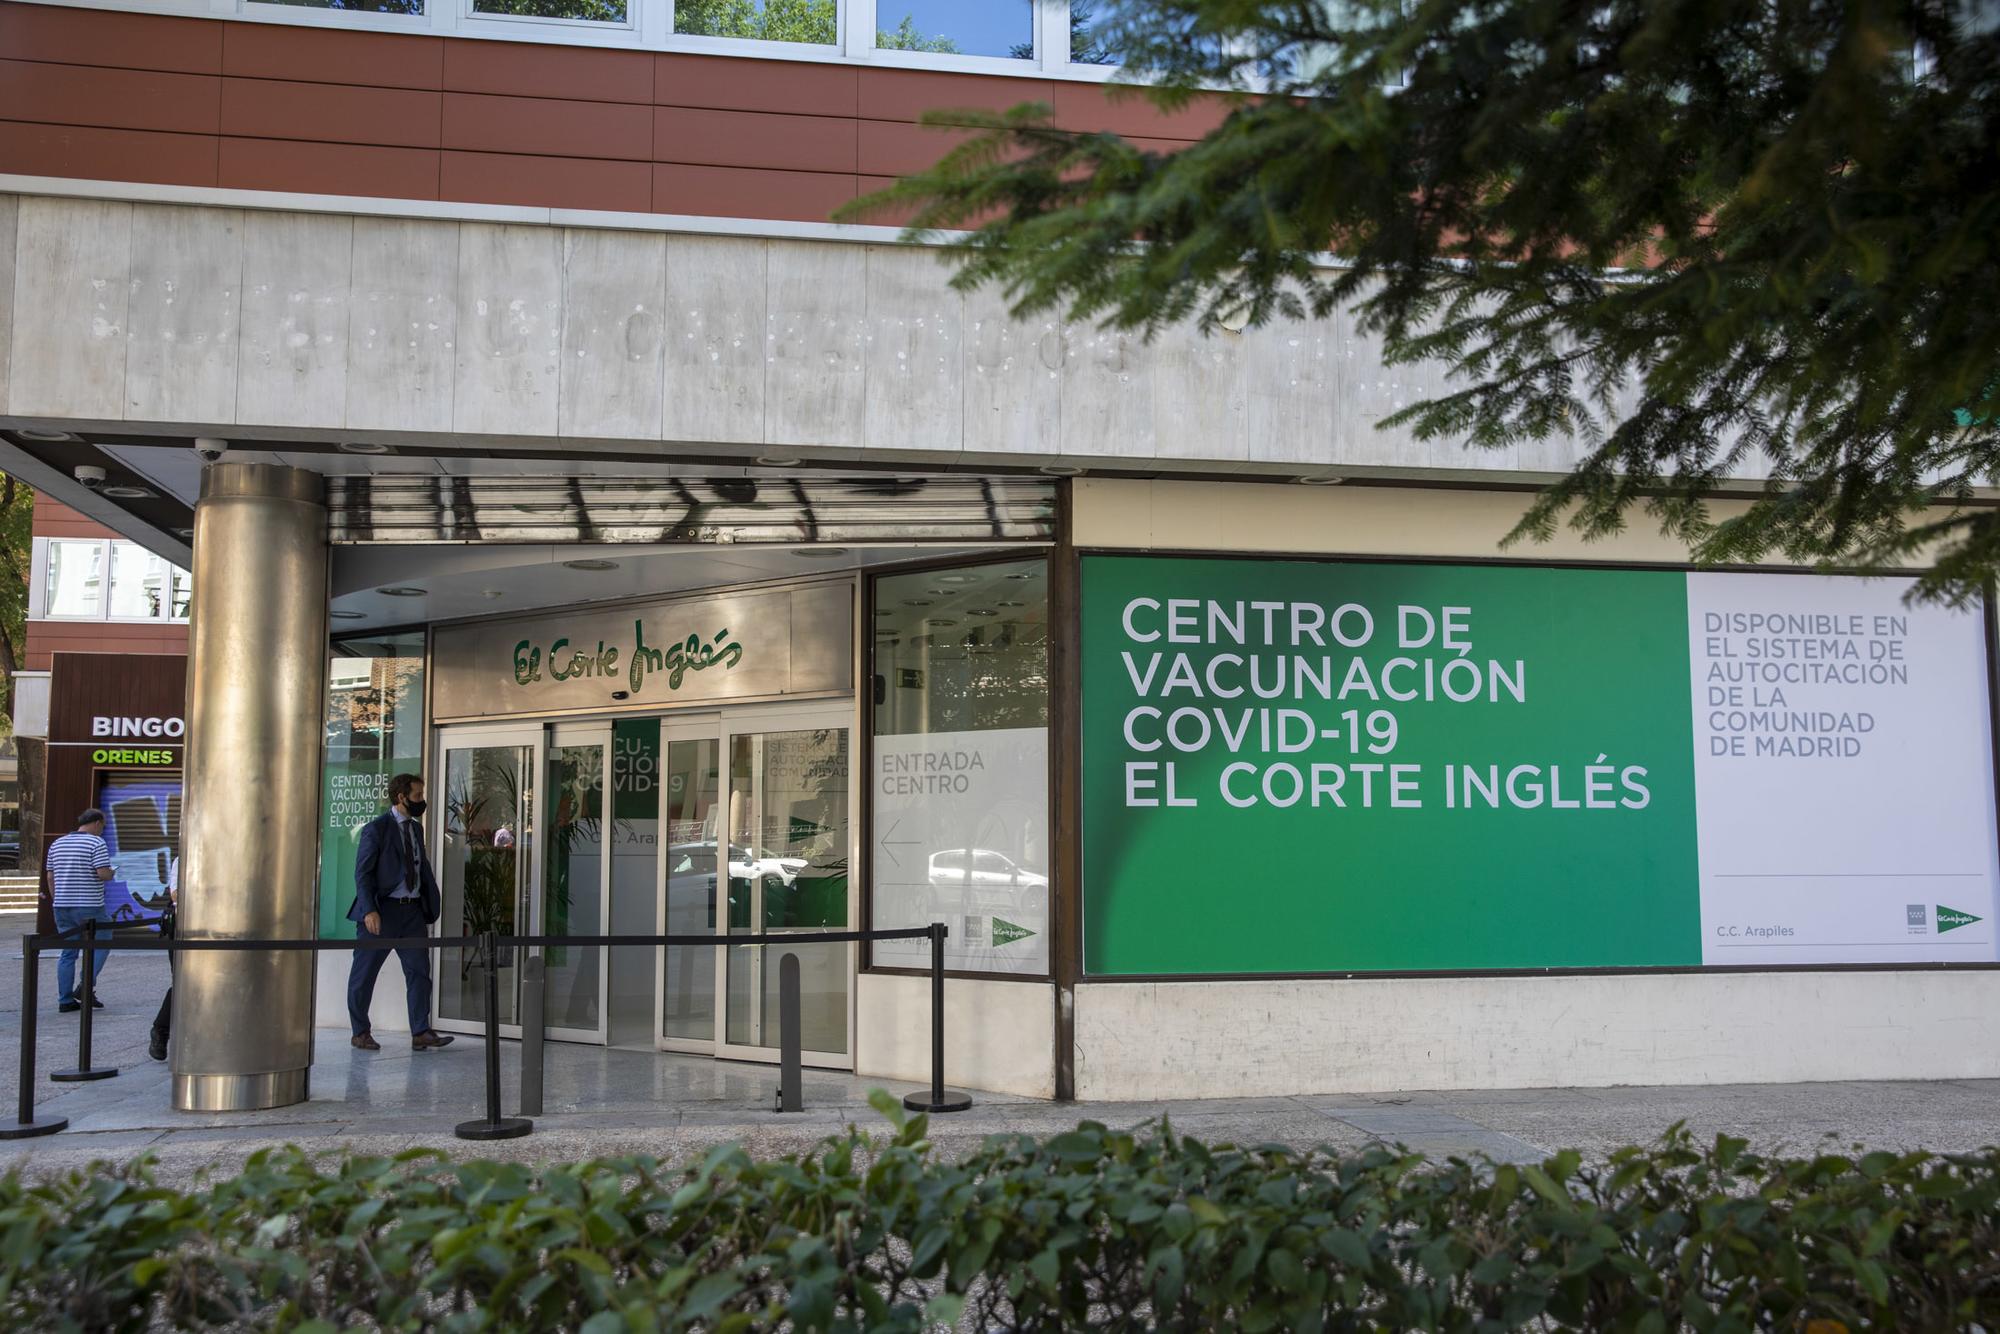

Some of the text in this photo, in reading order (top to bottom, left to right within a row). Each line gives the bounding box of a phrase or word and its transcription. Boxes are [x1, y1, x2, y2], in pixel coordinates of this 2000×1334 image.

[1122, 597, 1473, 650] CENTRO DE
[1704, 612, 1908, 637] DISPONIBLE EN
[513, 618, 743, 694] El Corte Inglés
[1706, 637, 1904, 661] EL SISTEMA DE
[1120, 646, 1526, 703] VACUNACIÓN
[1706, 656, 1908, 685] AUTOCITACIÓN
[1708, 686, 1788, 708] DE LA
[92, 715, 185, 738] BINGO
[1123, 705, 1399, 755] COVID-19
[1708, 710, 1875, 734] COMUNIDAD
[92, 748, 174, 765] ORENES
[1710, 735, 1861, 758] DE MADRID
[881, 750, 985, 774] ENTRADA
[331, 773, 389, 788] CENTRO DE
[881, 773, 970, 796] CENTRO
[1125, 752, 1651, 809] EL CORTE INGLÉS
[330, 785, 389, 801] VACUNACIÓ
[330, 801, 375, 814] COVID-19
[329, 815, 342, 828] EL
[1716, 925, 1795, 938] C.C. Arapiles
